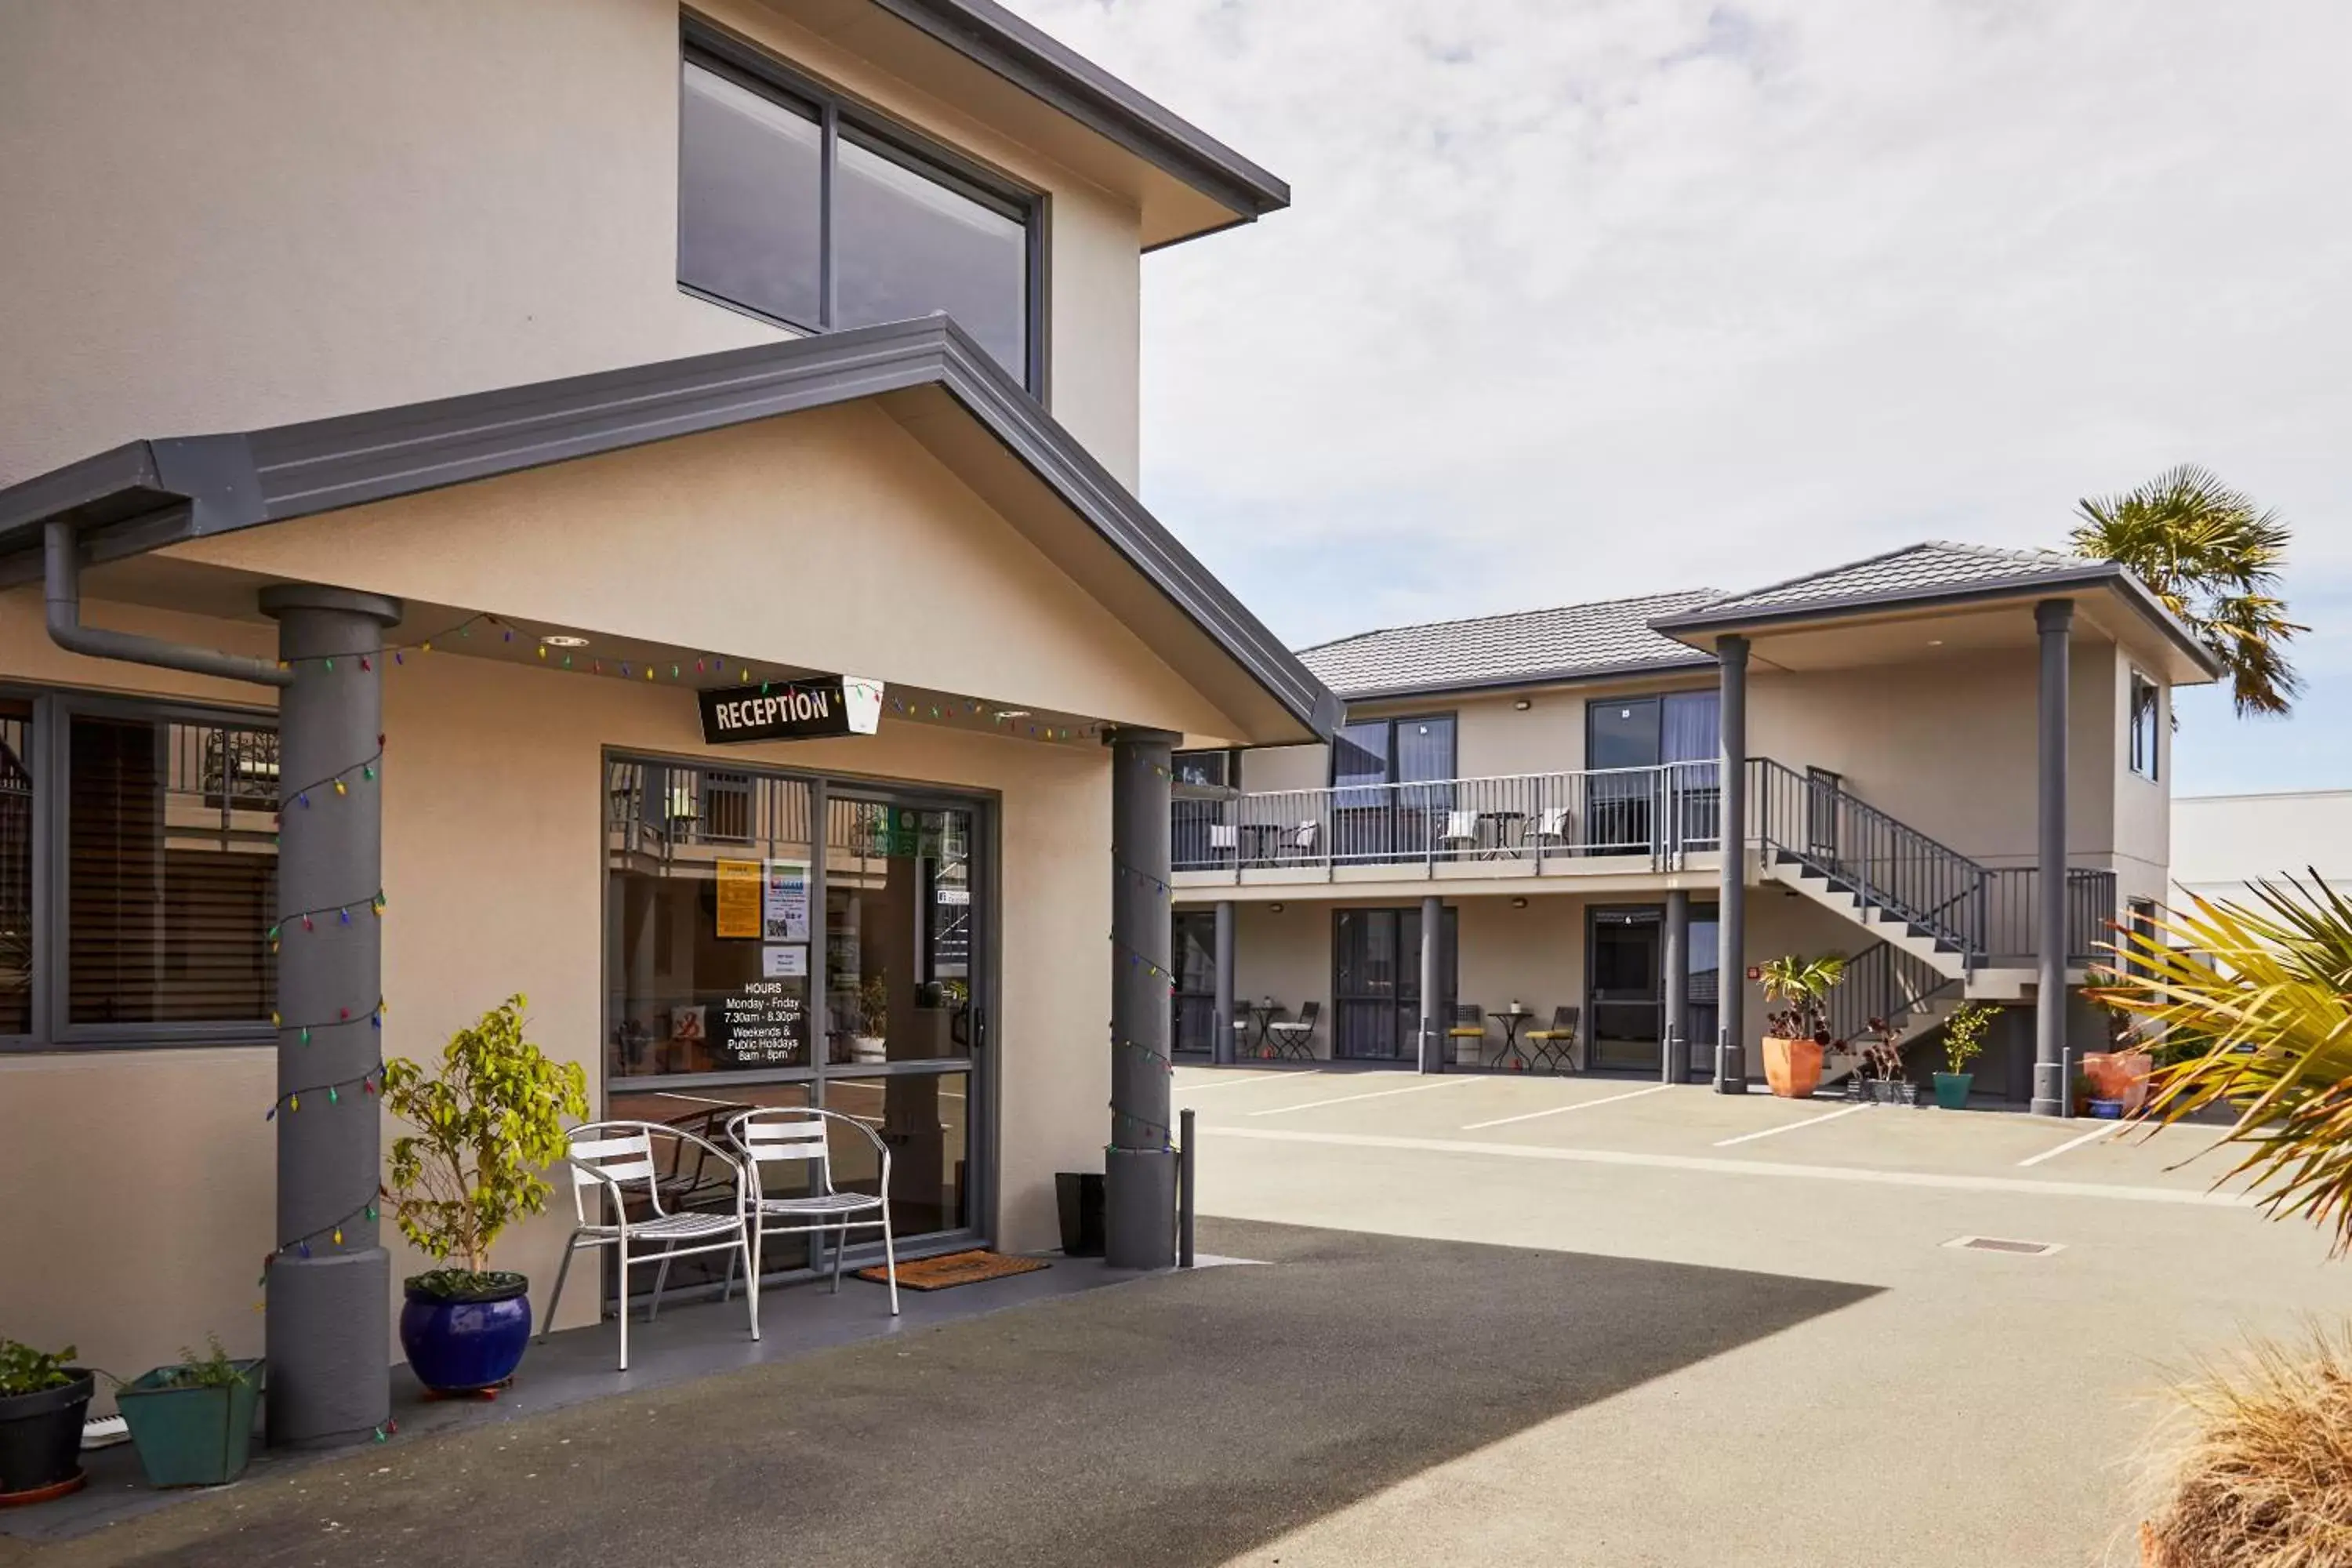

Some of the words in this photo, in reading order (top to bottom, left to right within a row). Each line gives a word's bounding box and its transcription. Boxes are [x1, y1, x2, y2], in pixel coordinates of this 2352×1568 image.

[716, 691, 829, 730] RECEPTION
[745, 982, 782, 994] HOURS
[726, 998, 764, 1011] Monday
[771, 996, 800, 1011] Friday
[724, 1012, 760, 1023] 7.30am
[768, 1011, 800, 1023] 8.30pm
[733, 1026, 782, 1037] Weekends
[783, 1025, 791, 1036] &
[728, 1039, 757, 1050] Public
[758, 1038, 799, 1050] Holidays
[739, 1051, 760, 1061] 8am
